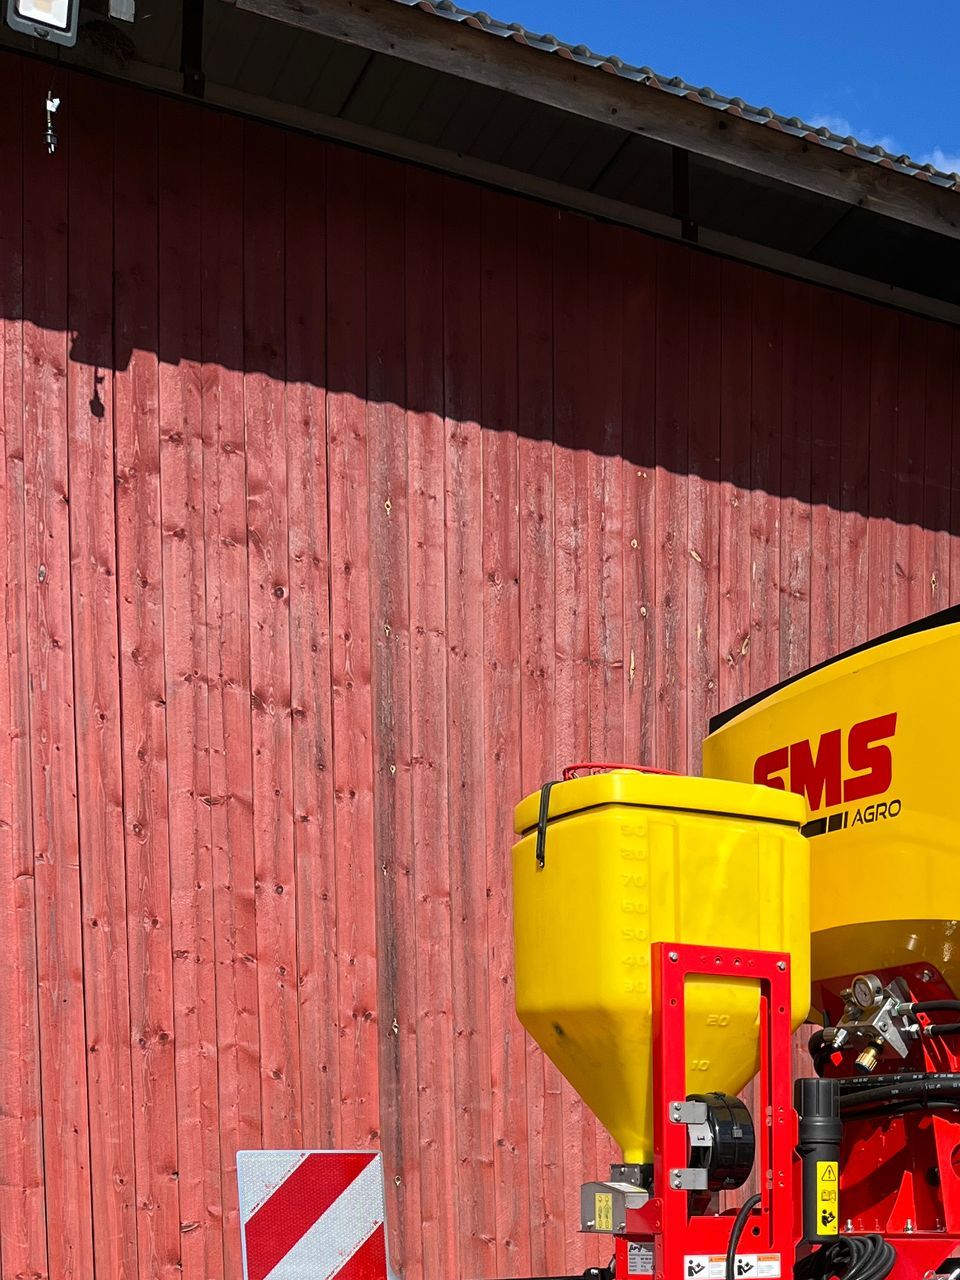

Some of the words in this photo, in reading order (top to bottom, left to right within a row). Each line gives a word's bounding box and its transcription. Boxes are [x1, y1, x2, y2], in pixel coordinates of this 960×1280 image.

[851, 799, 902, 827] AGRO
[622, 873, 648, 888] 70
[622, 927, 649, 941] 50
[622, 954, 649, 968] 40
[706, 1013, 731, 1028] 20
[690, 1059, 711, 1071] 10
